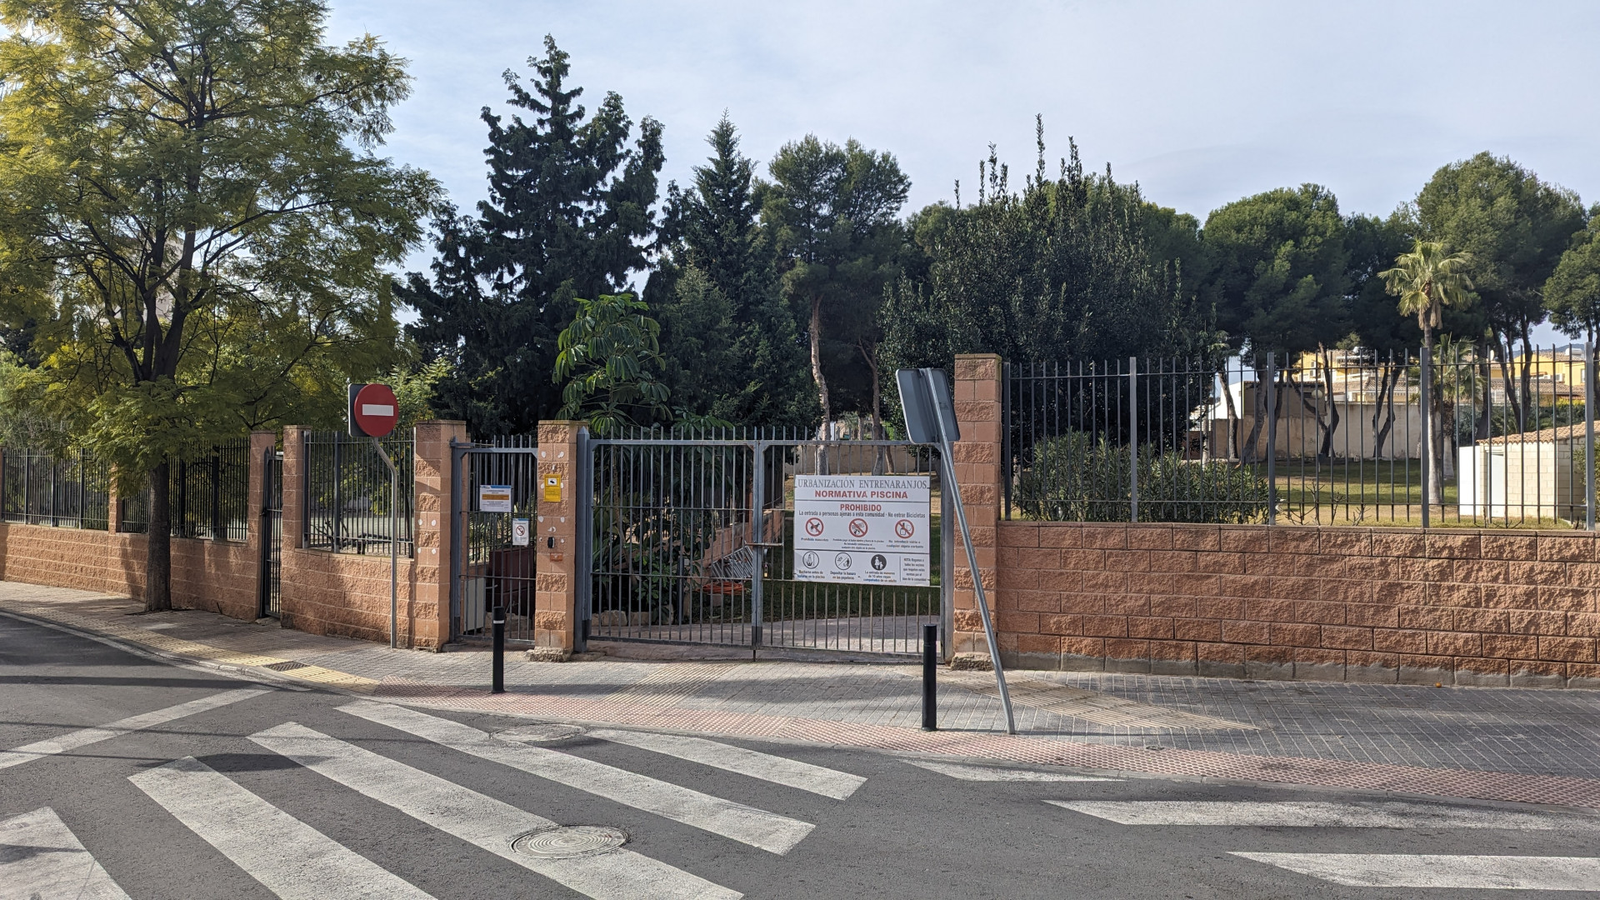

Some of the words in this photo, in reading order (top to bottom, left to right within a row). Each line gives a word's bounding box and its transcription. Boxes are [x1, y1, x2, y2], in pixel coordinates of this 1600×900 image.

[798, 477, 855, 489] URBANIZACIÓN
[859, 479, 927, 490] ENTRENARANJOS
[815, 490, 868, 498] NORMATIVA
[870, 490, 908, 499] PISCINA
[840, 504, 882, 512] PROHIBIDO
